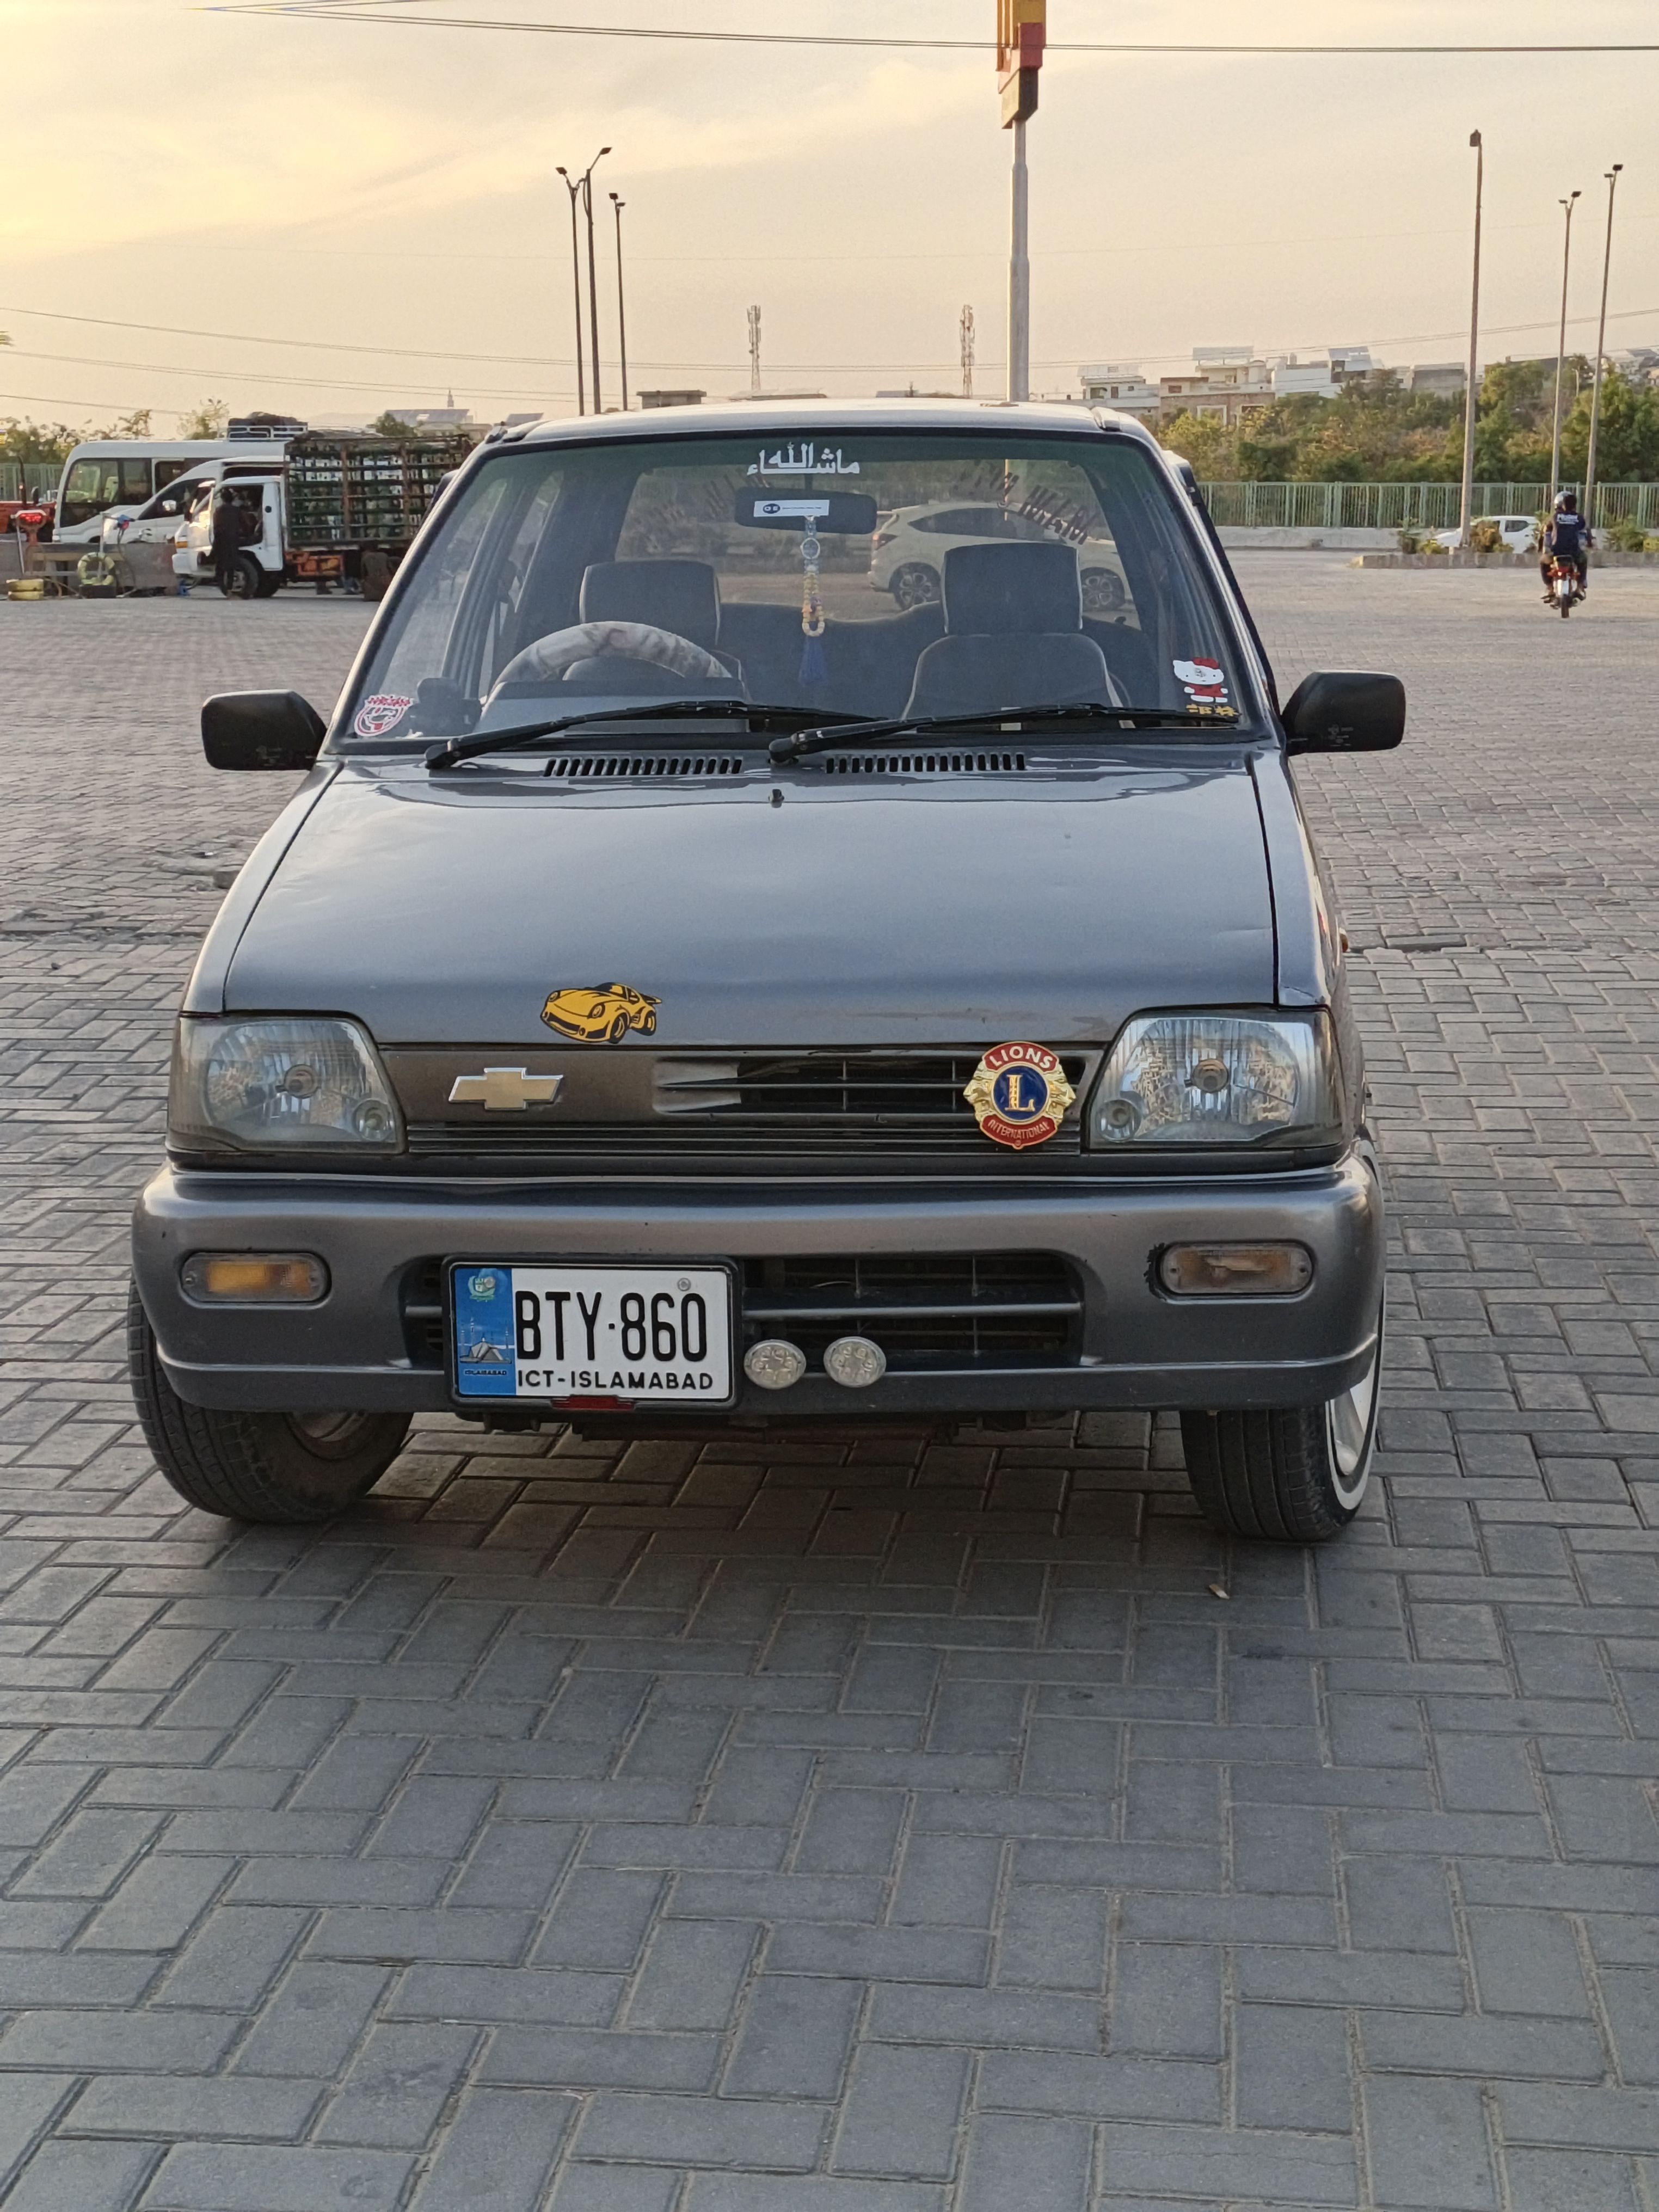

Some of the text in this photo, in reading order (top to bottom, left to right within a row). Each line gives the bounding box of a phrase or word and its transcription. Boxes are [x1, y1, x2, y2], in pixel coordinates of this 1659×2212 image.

[989, 1046, 1053, 1069] LIONS
[1004, 1074, 1036, 1111] L
[987, 1119, 1050, 1140] INTERNATIONAL
[518, 1369, 714, 1390] ICT-ISLAMABAD
